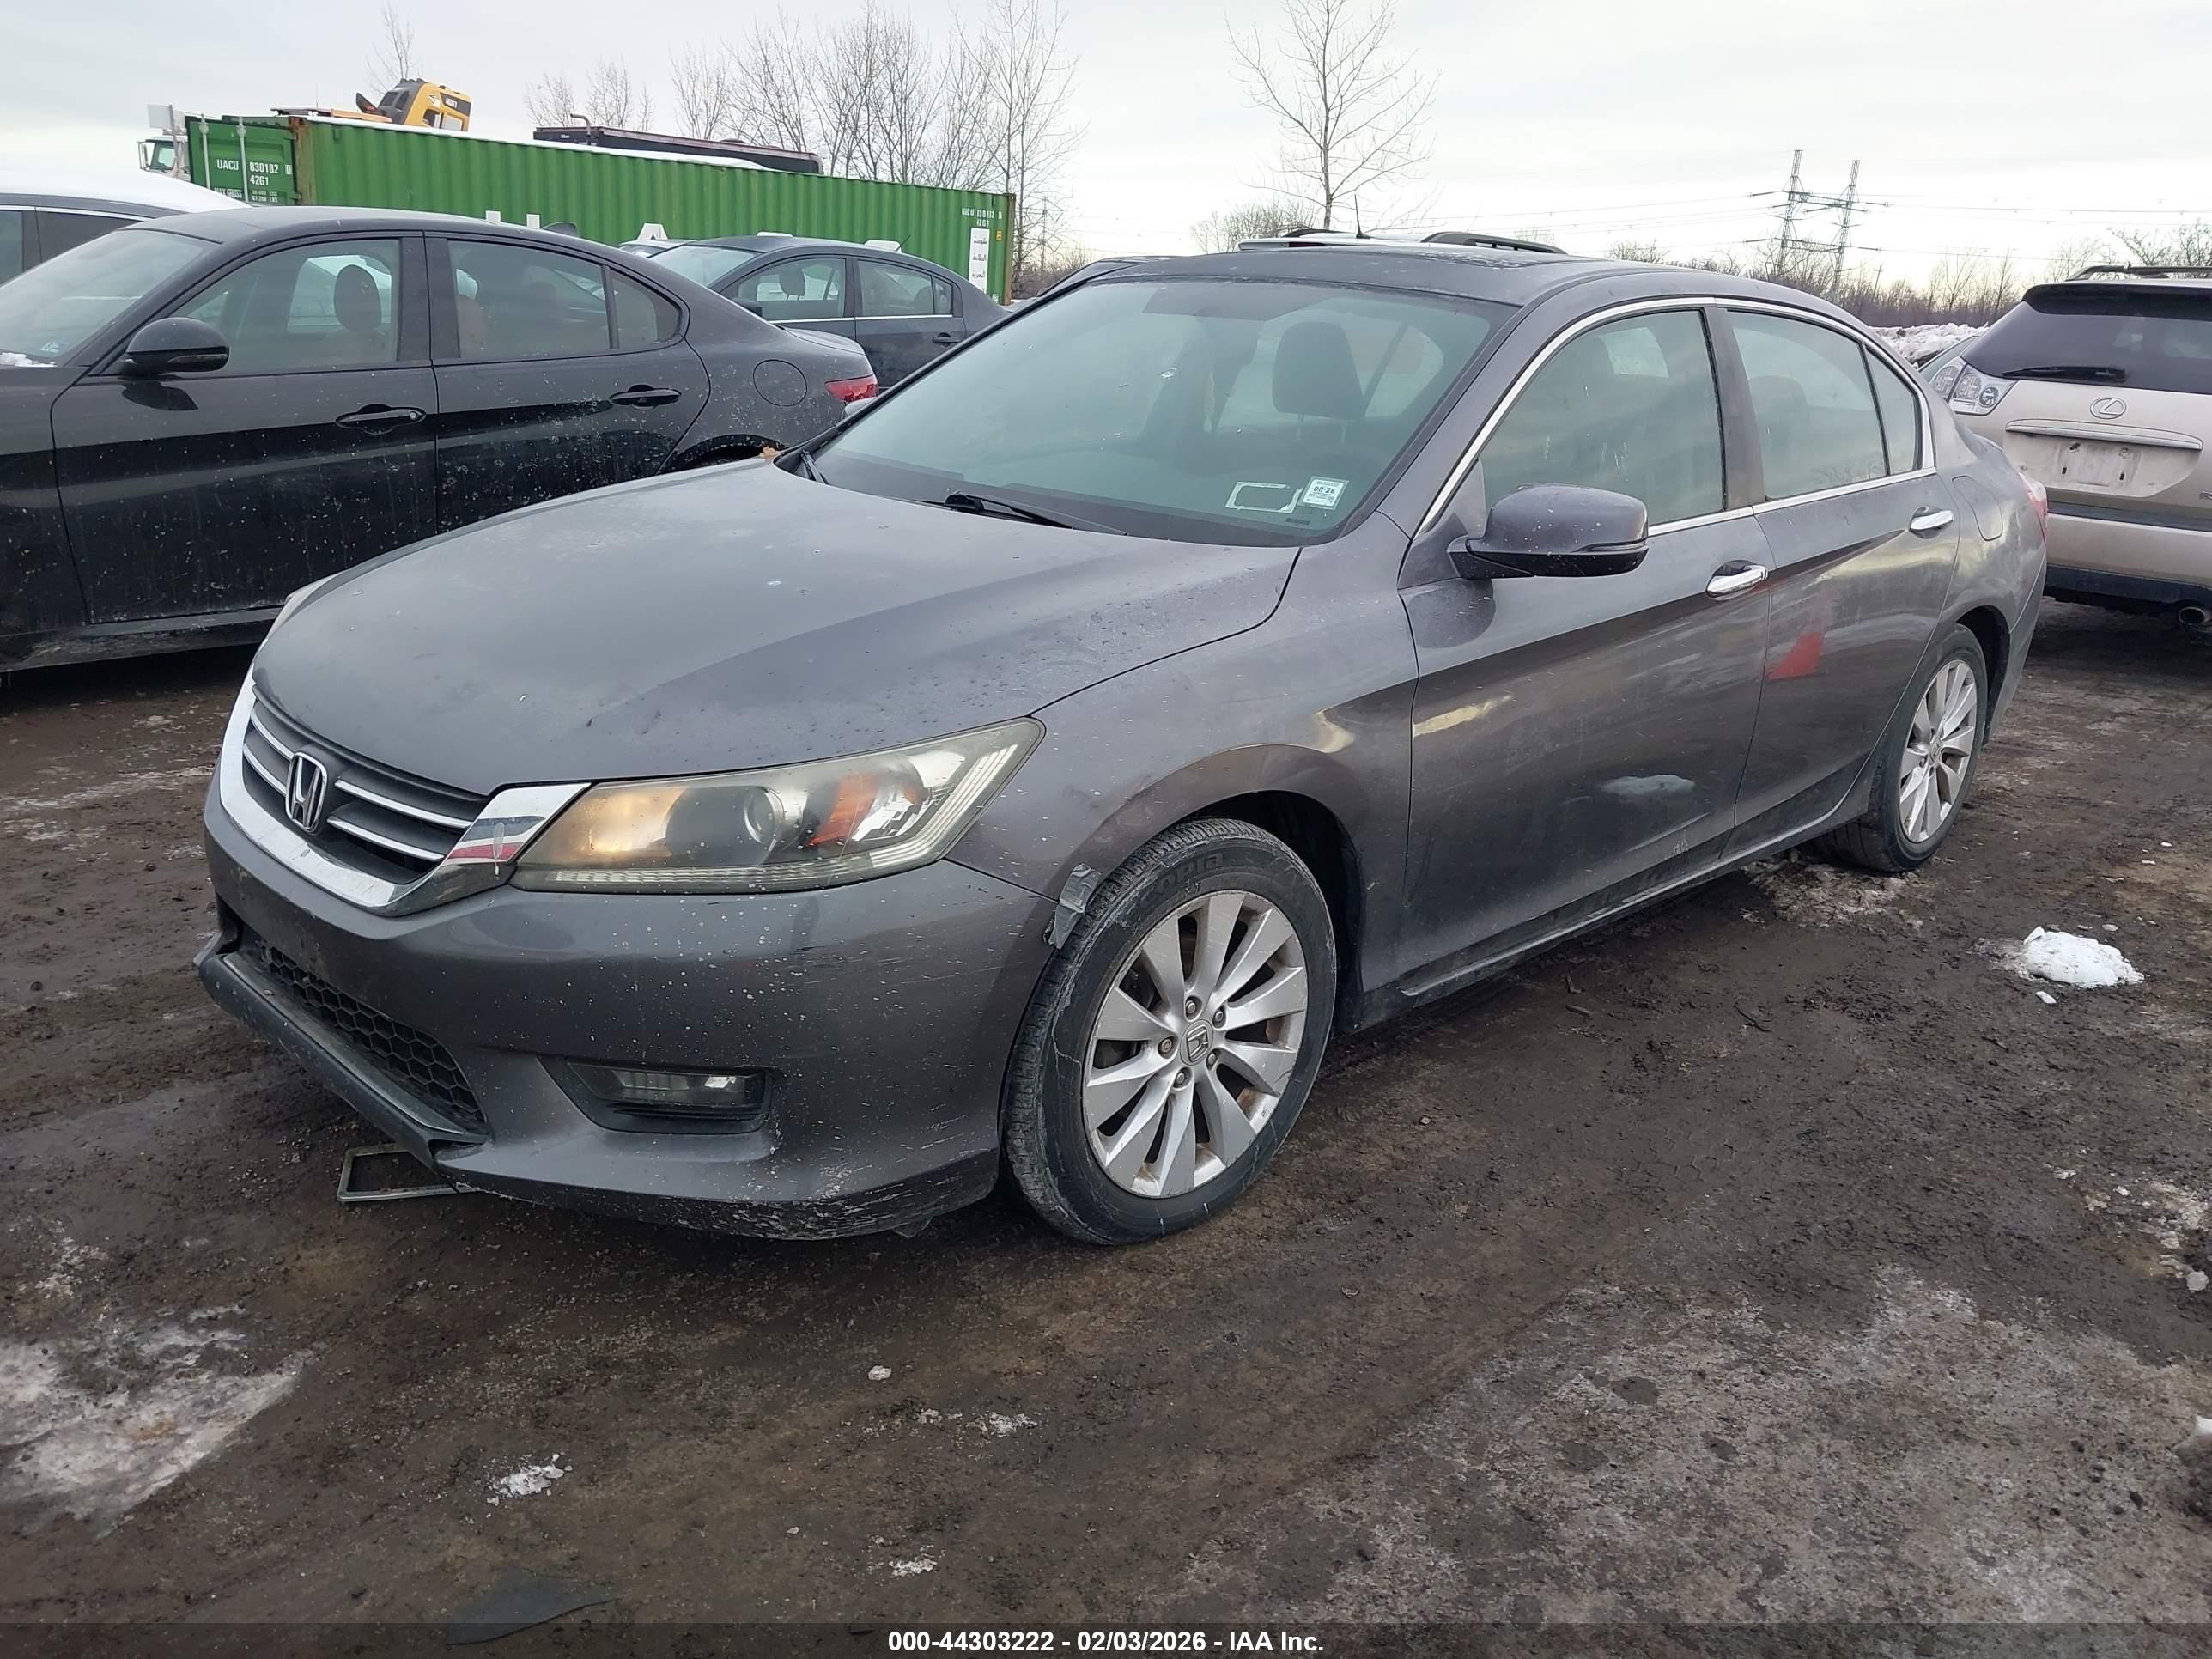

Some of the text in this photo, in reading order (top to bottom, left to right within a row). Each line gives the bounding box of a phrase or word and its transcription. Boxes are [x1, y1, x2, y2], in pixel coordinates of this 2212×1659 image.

[216, 159, 239, 170] UACU
[249, 161, 280, 174] 830182
[250, 174, 270, 186] 42G1
